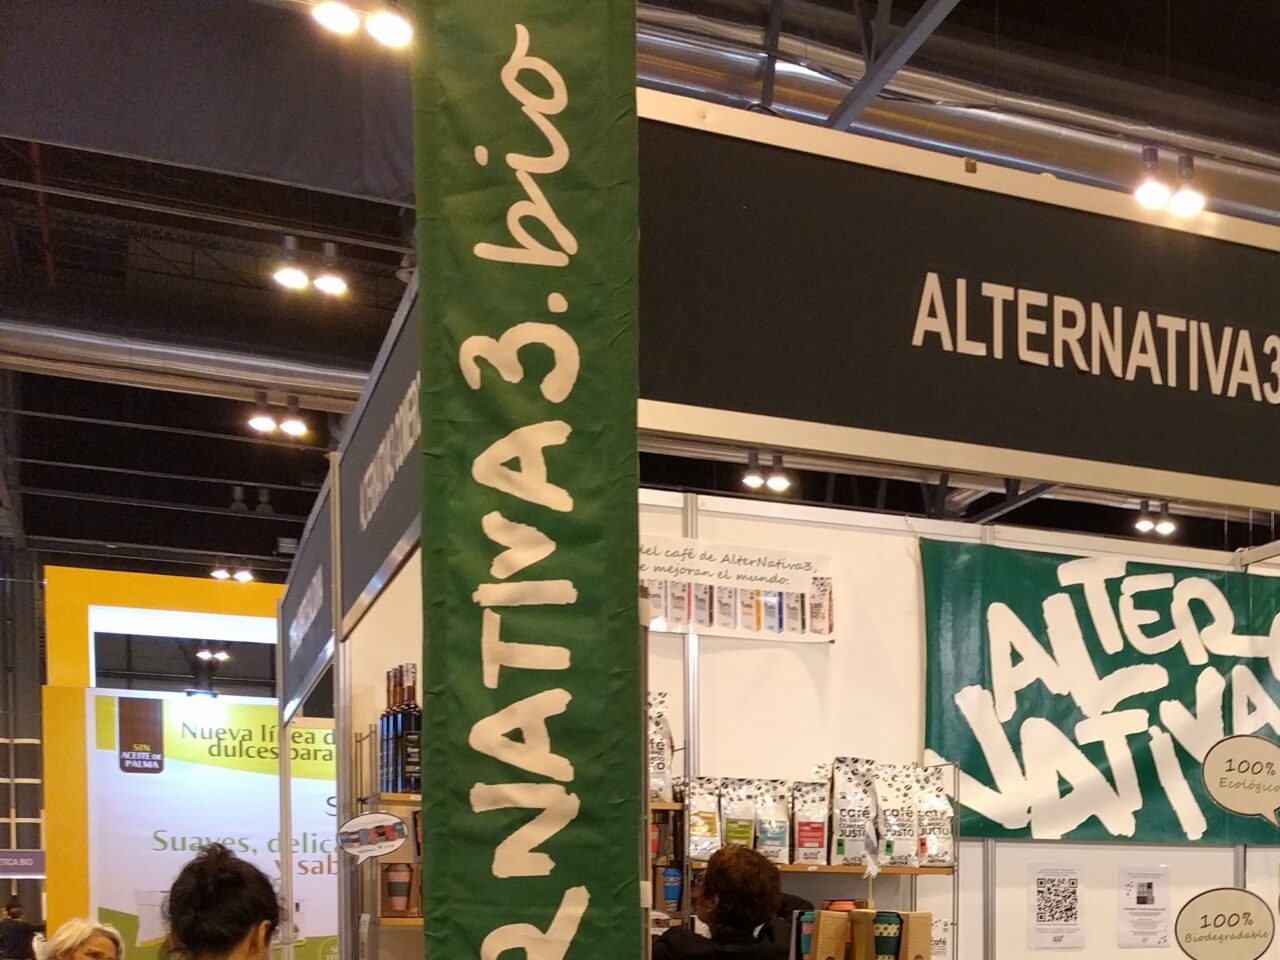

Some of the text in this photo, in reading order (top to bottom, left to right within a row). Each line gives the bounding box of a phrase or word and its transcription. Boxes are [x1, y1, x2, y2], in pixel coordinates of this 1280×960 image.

[664, 548, 697, 563] café
[699, 552, 717, 563] de
[653, 564, 714, 578] mejoran
[718, 568, 732, 580] el
[985, 557, 1269, 722] ALTER
[181, 720, 253, 742] Nueva
[261, 723, 316, 744] líea
[208, 738, 280, 759] dulces
[124, 759, 160, 769] PALMA
[1225, 758, 1277, 776] 100%
[839, 805, 871, 818] café
[883, 805, 915, 818] café
[1199, 911, 1254, 930] 100%
[1184, 930, 1270, 945] Biodegradable
